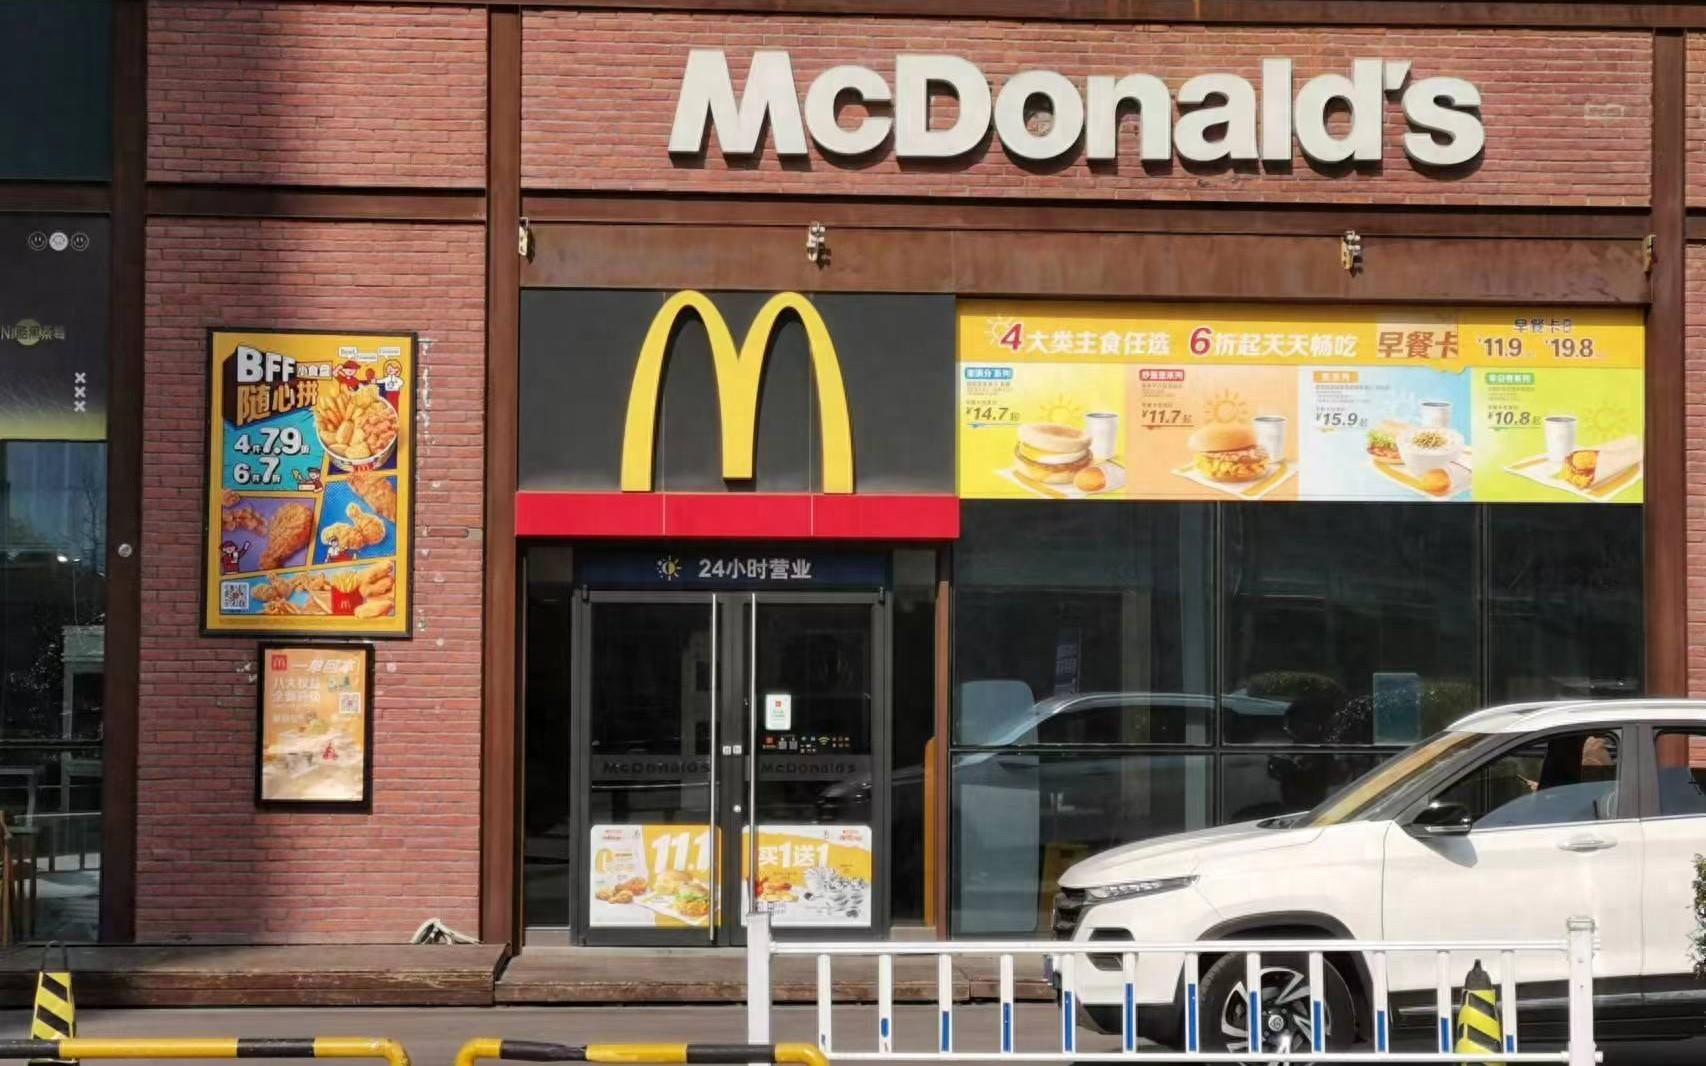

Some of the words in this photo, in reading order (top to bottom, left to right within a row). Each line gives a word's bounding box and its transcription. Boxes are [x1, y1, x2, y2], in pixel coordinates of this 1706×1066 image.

[668, 49, 1485, 167] McDonald's
[999, 323, 1171, 356] 4大类主食任选
[1189, 326, 1359, 358] 6折起天天畅吃
[1378, 331, 1458, 358] 早餐卡
[237, 346, 296, 383] BFF
[236, 380, 319, 426] 随心拼
[698, 558, 812, 579] 24小时营业
